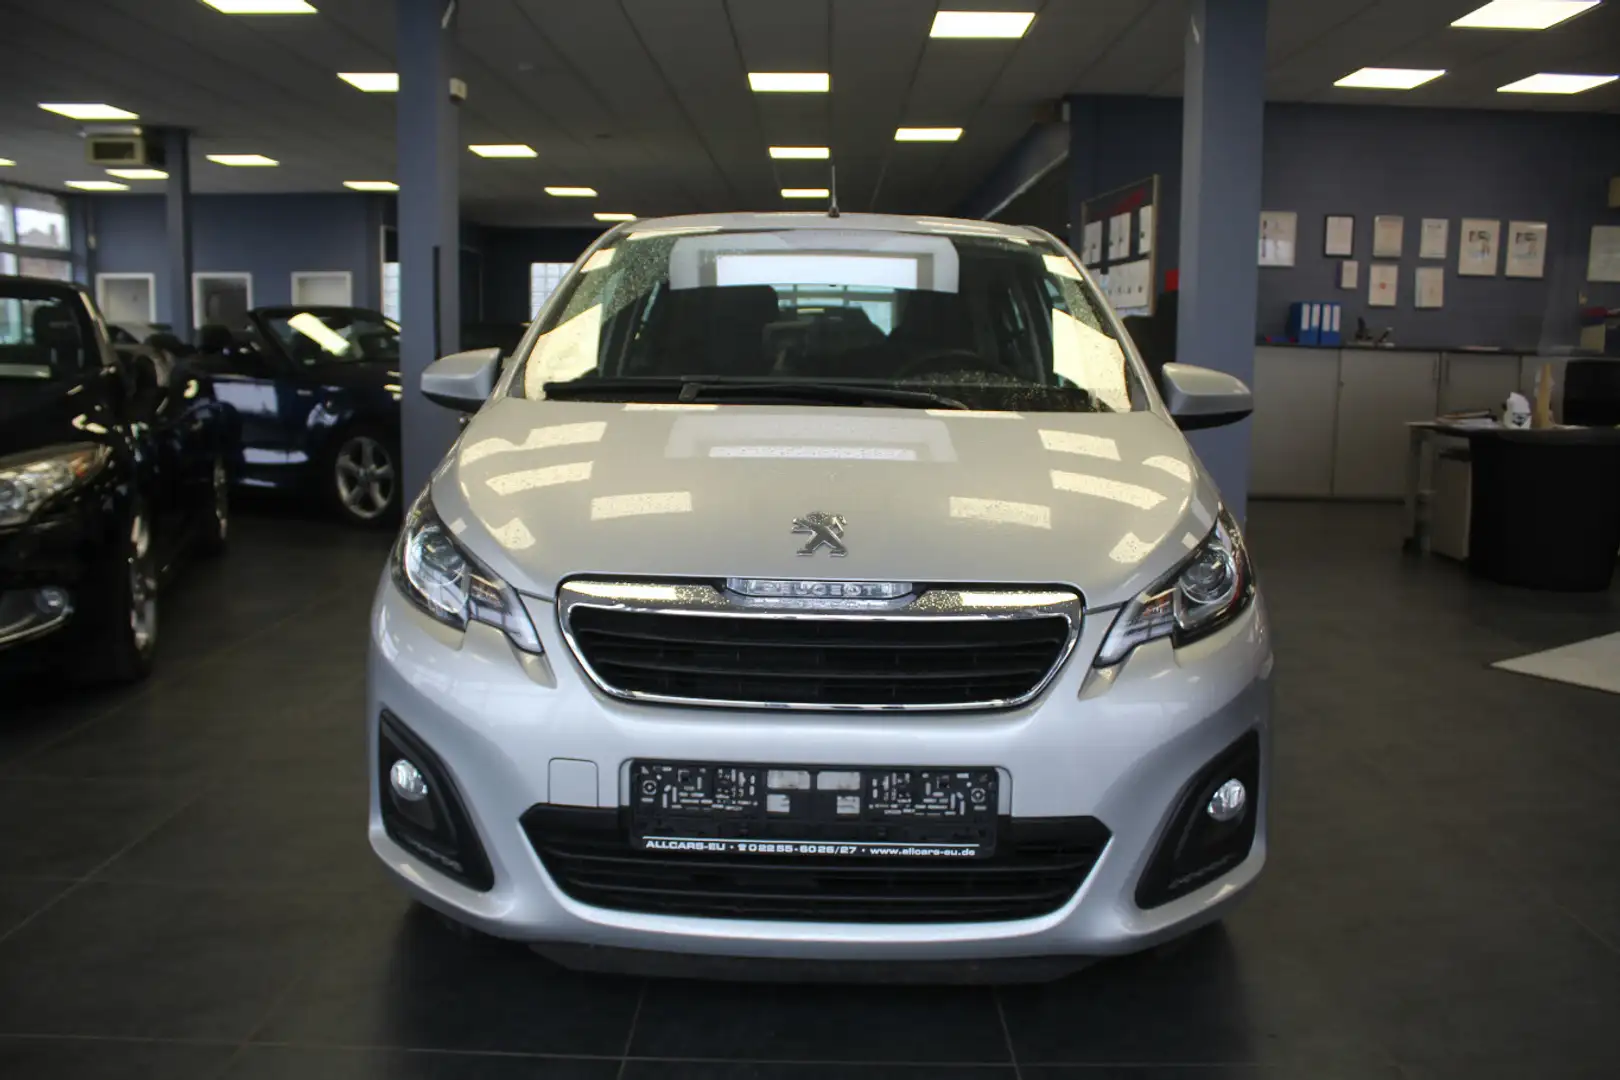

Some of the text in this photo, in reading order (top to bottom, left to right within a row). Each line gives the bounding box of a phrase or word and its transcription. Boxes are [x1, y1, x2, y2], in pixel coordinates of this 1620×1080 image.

[762, 582, 877, 596] PEUGEOT
[646, 840, 726, 851] ALLCARS-EU
[870, 847, 976, 856] www.allcars-eu.de
